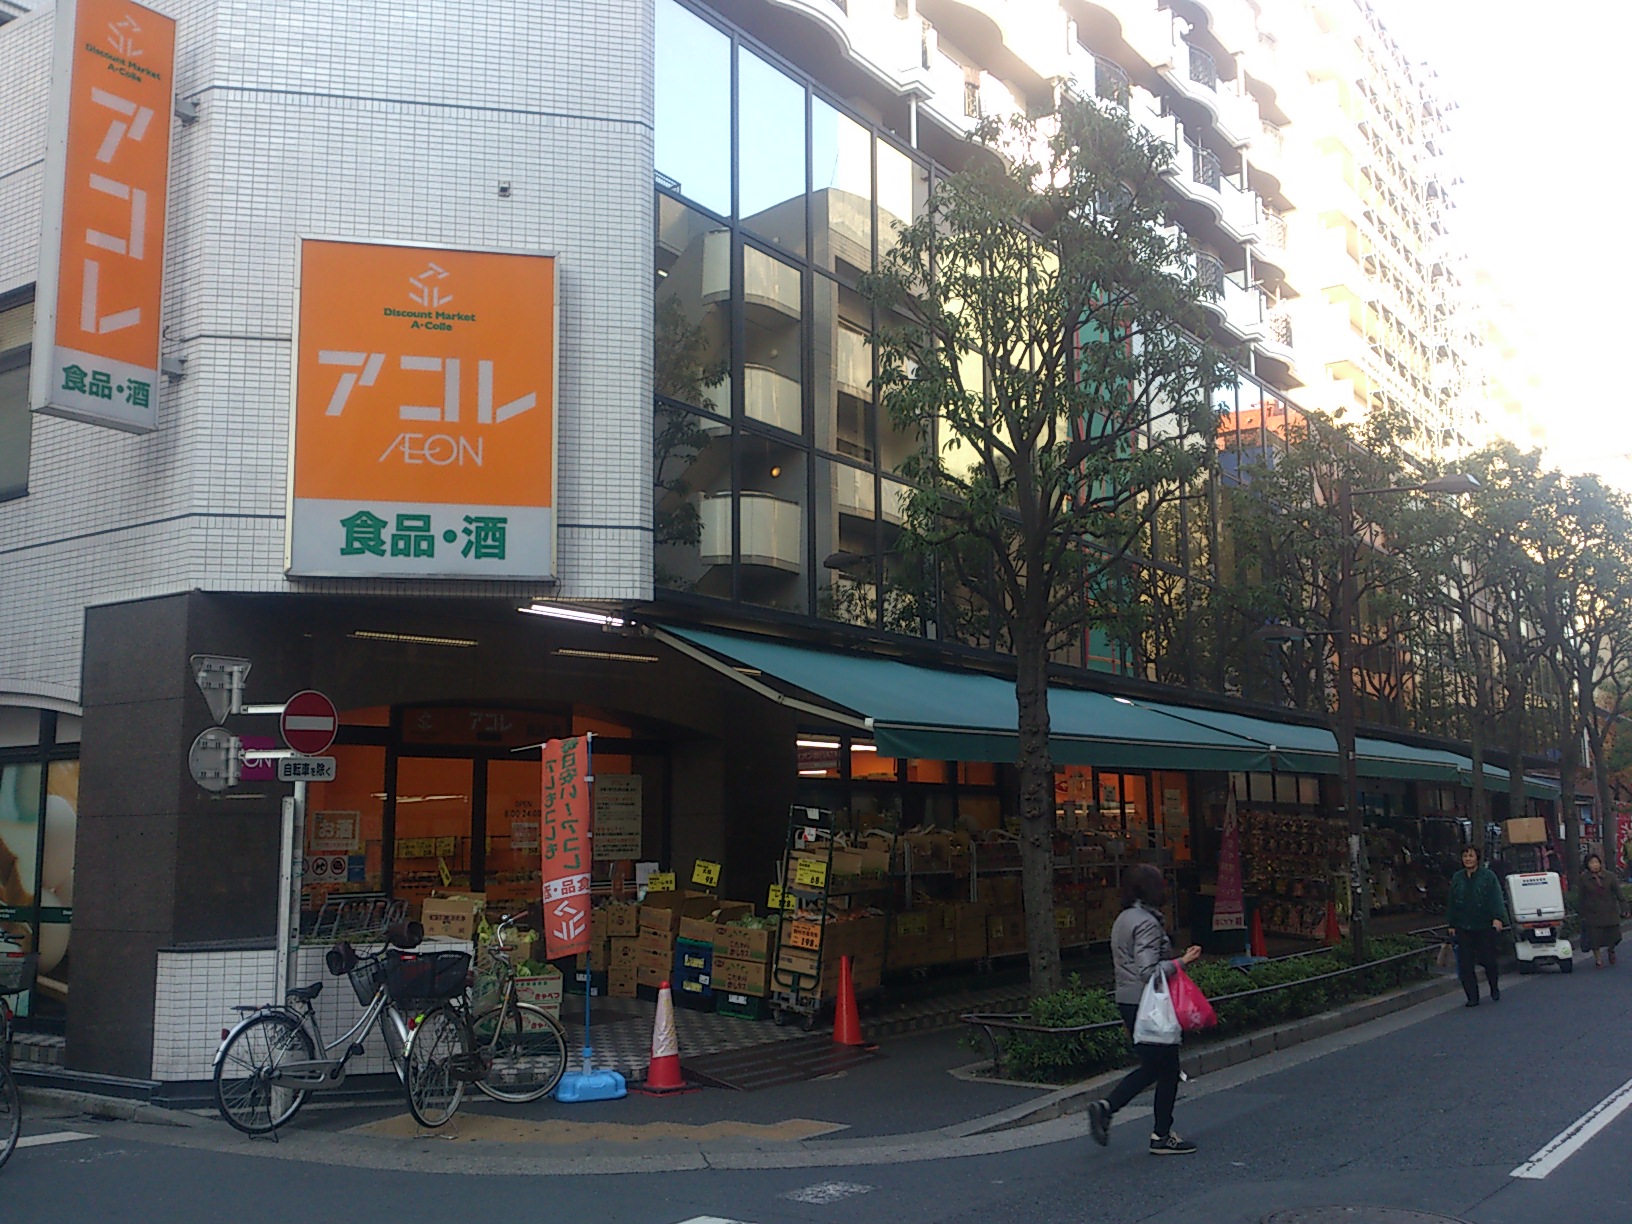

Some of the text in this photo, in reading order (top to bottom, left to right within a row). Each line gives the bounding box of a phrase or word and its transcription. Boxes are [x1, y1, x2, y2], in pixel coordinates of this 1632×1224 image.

[127, 61, 161, 81] Market
[81, 86, 155, 335] アコレ
[383, 307, 476, 322] Discount Market
[317, 350, 538, 425] アコレ
[339, 509, 509, 560] 食品・酒
[468, 711, 512, 732] アコレ
[283, 762, 331, 777] 自転車を除く
[318, 818, 354, 839] お酒
